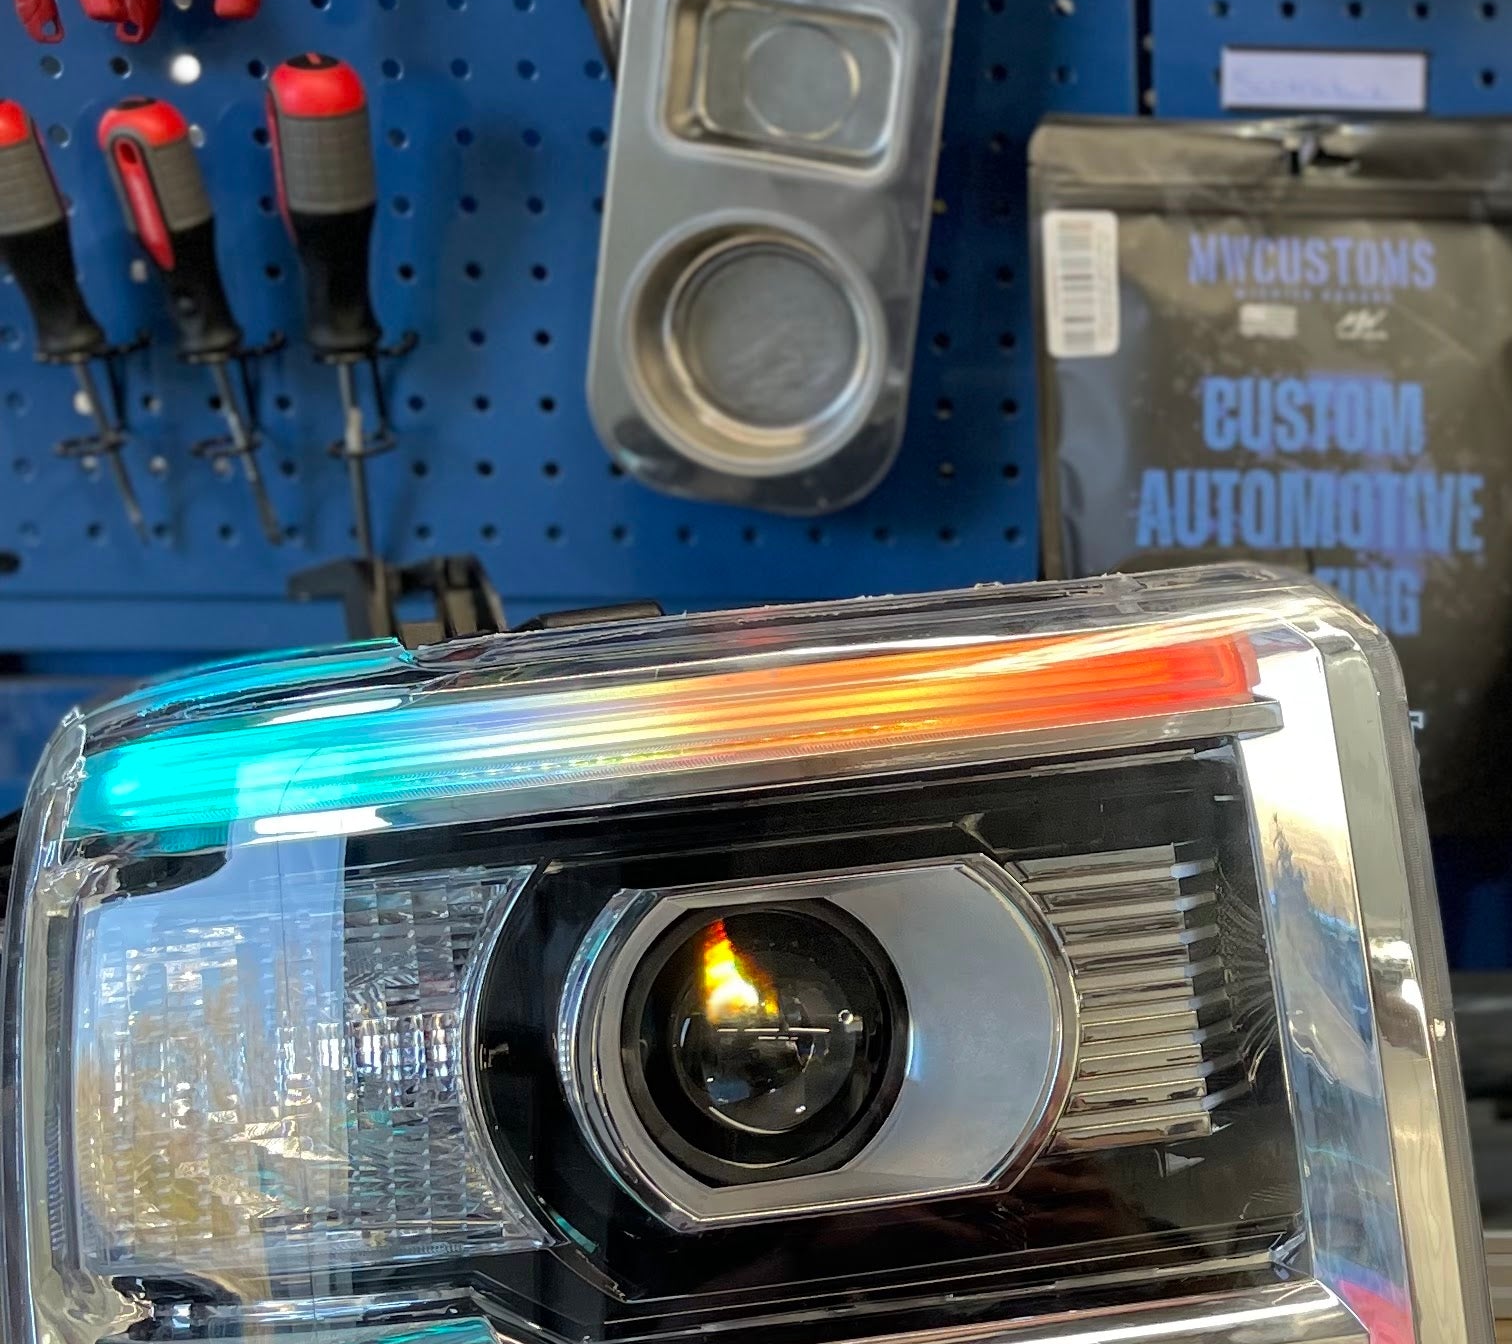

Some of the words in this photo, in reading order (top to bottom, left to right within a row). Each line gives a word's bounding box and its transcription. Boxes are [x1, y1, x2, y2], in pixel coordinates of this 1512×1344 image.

[1188, 232, 1437, 289] MWCUSTOMS
[1203, 375, 1425, 455] CUSTOM
[1136, 468, 1485, 553] AUTOMOTIVE
